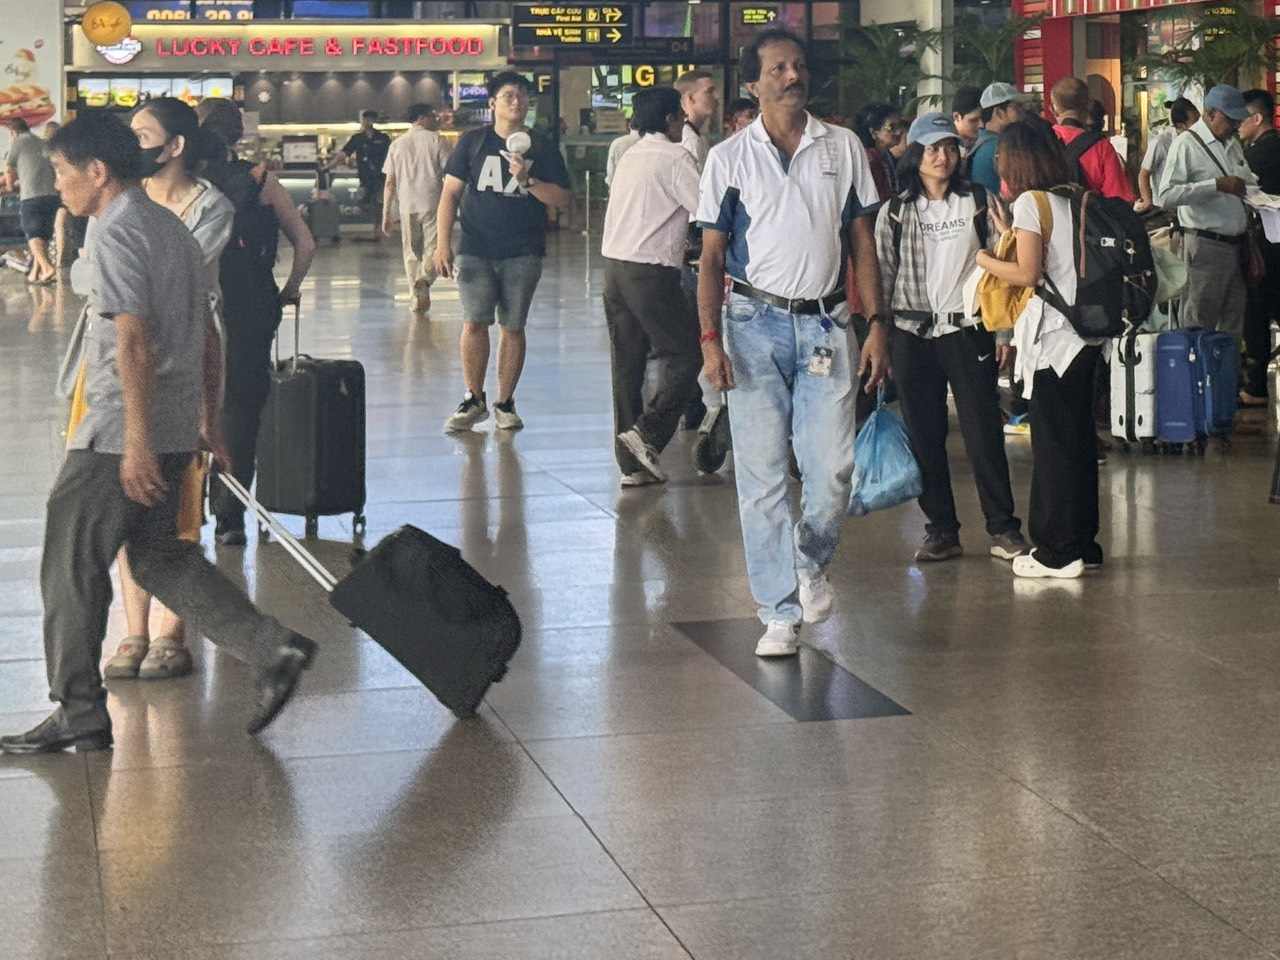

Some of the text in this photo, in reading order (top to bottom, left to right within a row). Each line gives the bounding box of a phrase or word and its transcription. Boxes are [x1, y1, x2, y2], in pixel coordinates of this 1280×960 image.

[156, 37, 241, 57] LUCKY
[250, 37, 314, 56] CAFE
[325, 37, 342, 55] &
[353, 37, 483, 56] FASTFOOD
[538, 75, 552, 93] F
[636, 65, 656, 87] G
